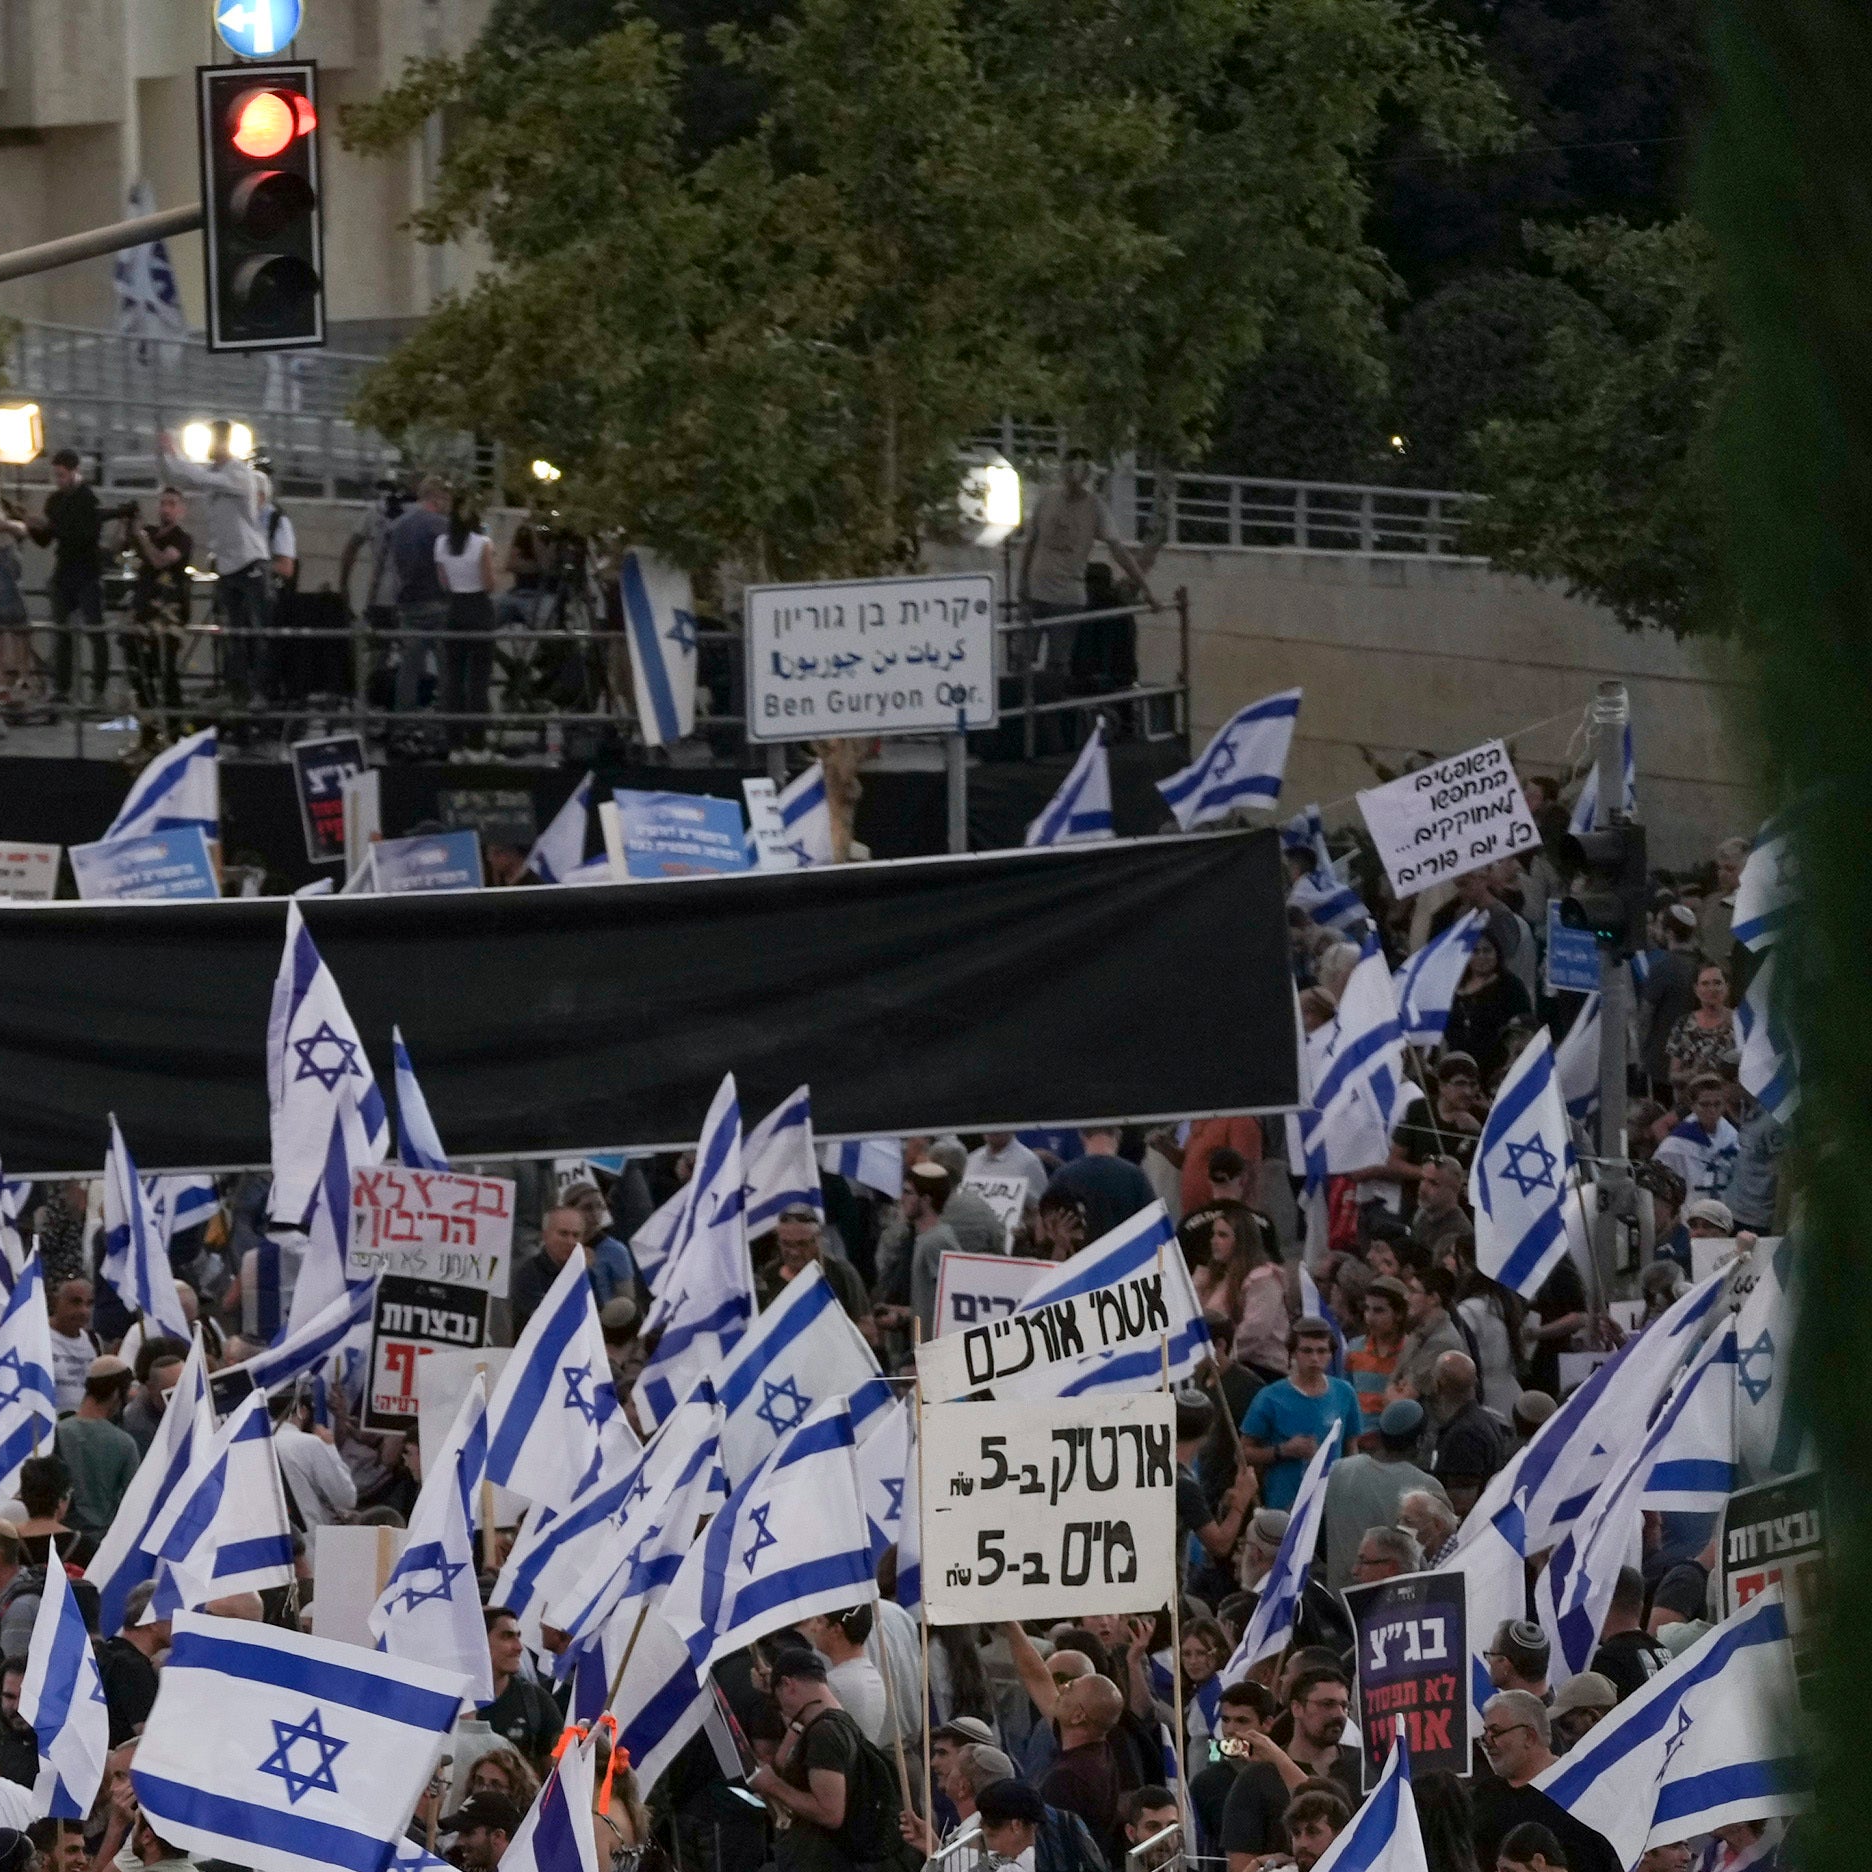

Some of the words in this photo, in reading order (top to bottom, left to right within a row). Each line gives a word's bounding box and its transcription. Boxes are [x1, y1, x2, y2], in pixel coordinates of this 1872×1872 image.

[773, 604, 845, 639] גוריון
[859, 602, 885, 635] בן
[899, 596, 970, 628] קרית
[764, 693, 797, 718] Ben
[827, 685, 924, 717] Guryon
[935, 682, 983, 709] Qr.
[1416, 748, 1501, 793] השופטים
[1470, 832, 1500, 862] יום
[381, 1301, 479, 1345] נבצרות
[1370, 1616, 1448, 1672] בג"צ
[1425, 1673, 1457, 1703] לא
